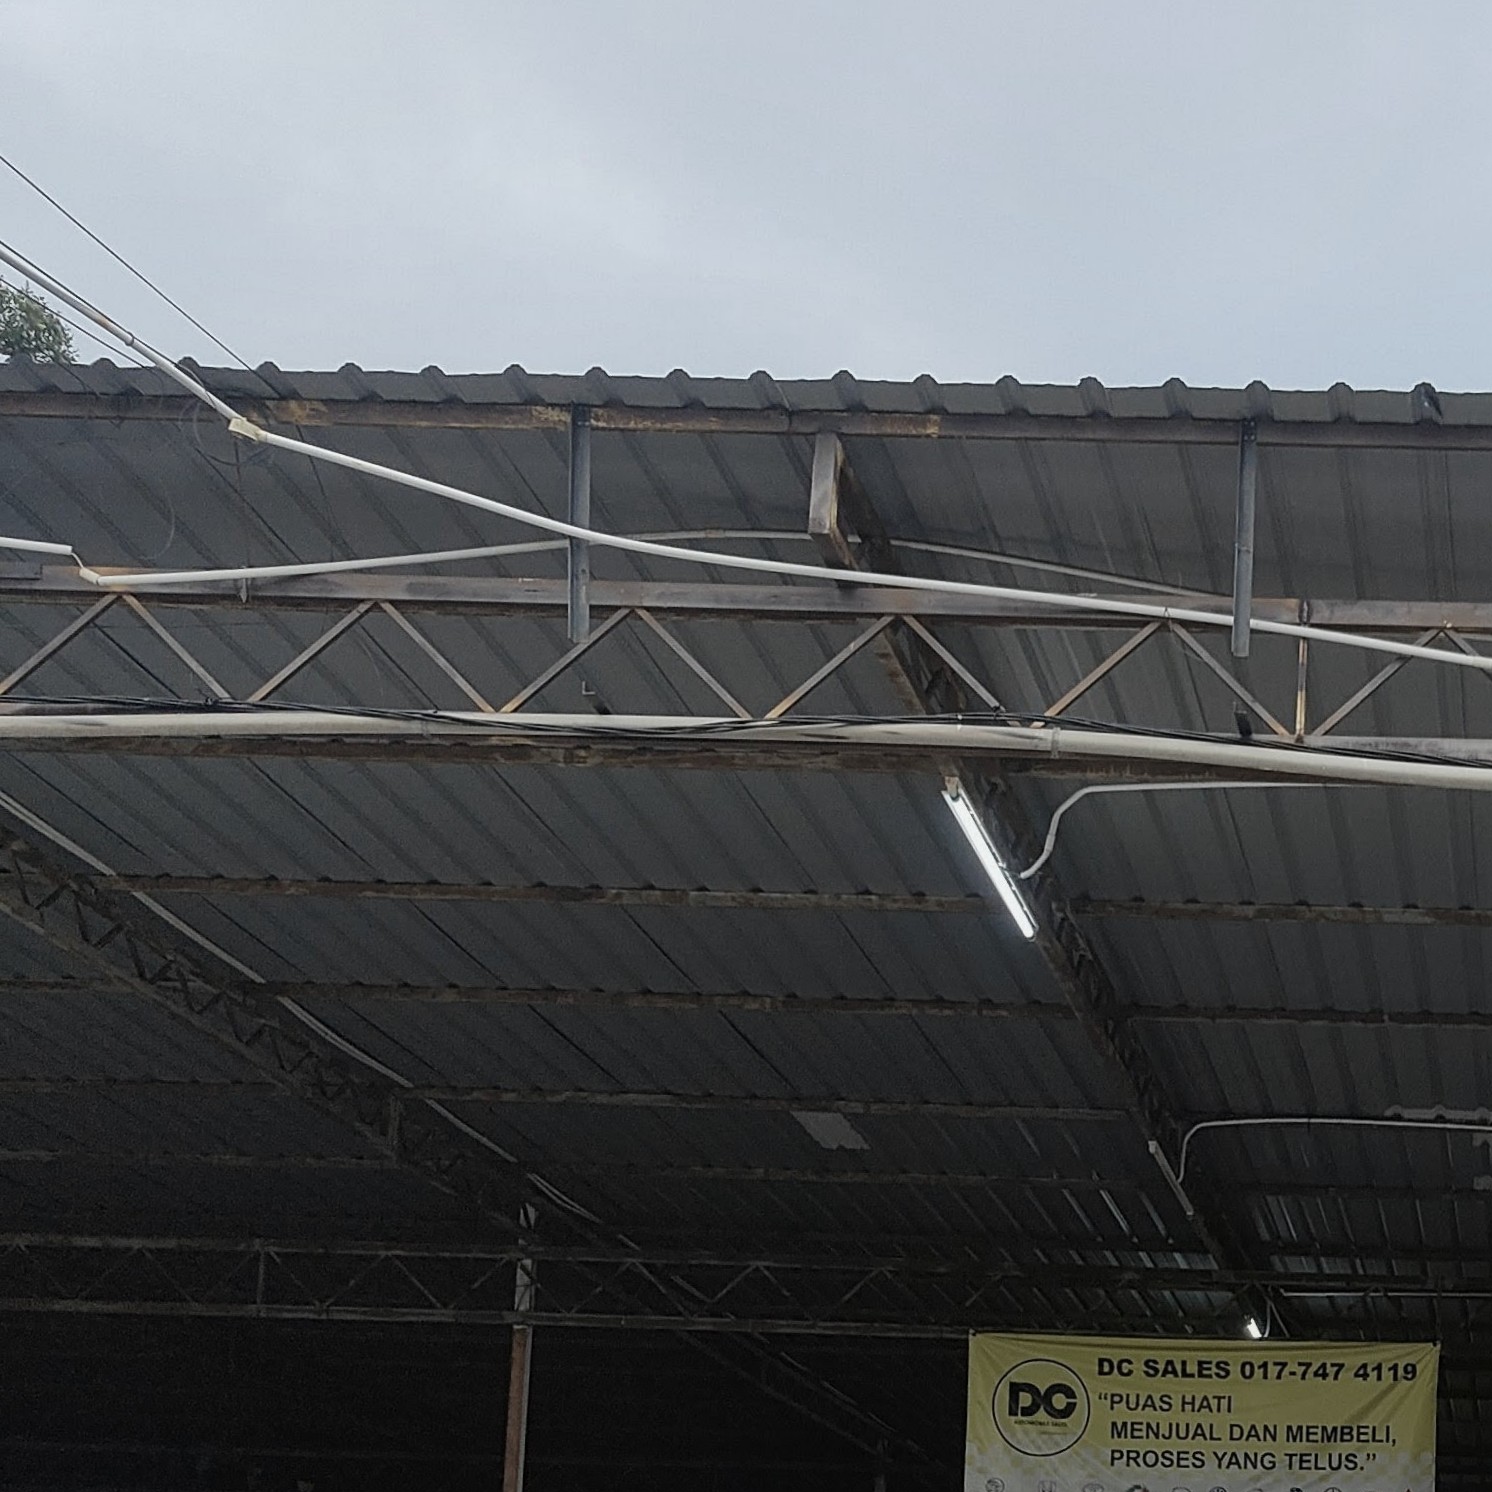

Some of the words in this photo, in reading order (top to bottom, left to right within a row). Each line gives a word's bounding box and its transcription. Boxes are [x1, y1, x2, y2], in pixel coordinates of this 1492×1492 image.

[1097, 1356, 1135, 1377] DC
[1142, 1358, 1231, 1379] SALES
[1239, 1360, 1345, 1382] 017-747
[1354, 1361, 1418, 1383] 4119
[1008, 1380, 1078, 1420] DC
[1181, 1394, 1232, 1414] HATI
[1110, 1420, 1217, 1442] MENJUAL
[1229, 1423, 1278, 1443] DAN
[1285, 1424, 1396, 1447] MEMBELI,
[1110, 1449, 1206, 1470] PROSES
[1213, 1452, 1277, 1471] YANG
